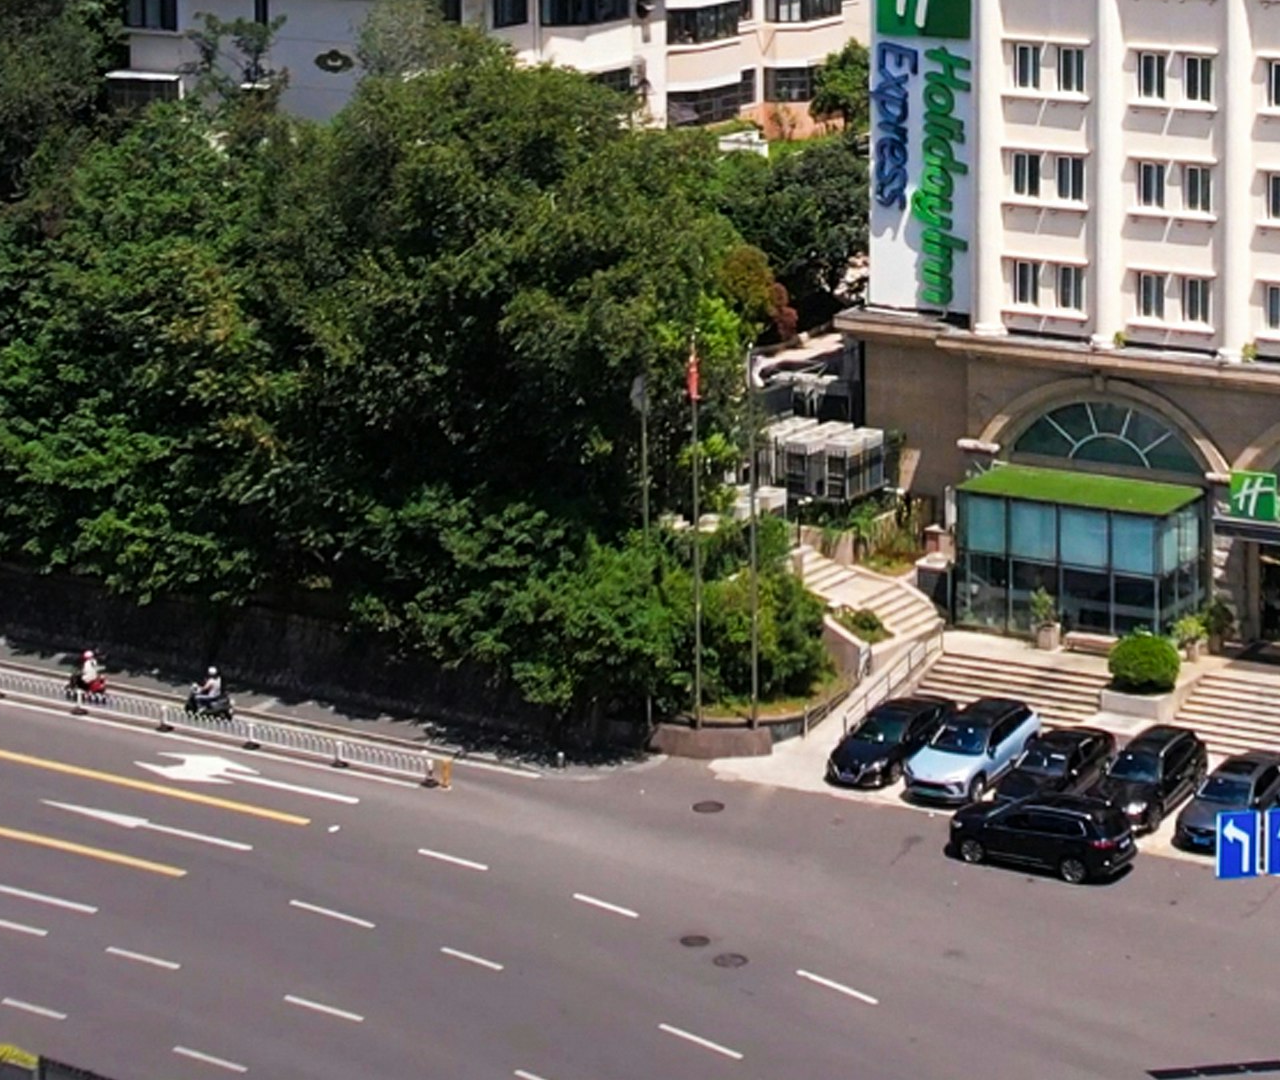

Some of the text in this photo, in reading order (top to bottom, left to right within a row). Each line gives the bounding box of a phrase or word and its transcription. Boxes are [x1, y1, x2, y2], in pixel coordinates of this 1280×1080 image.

[870, 41, 918, 211] Express
[911, 46, 971, 305] Holiday Inn
